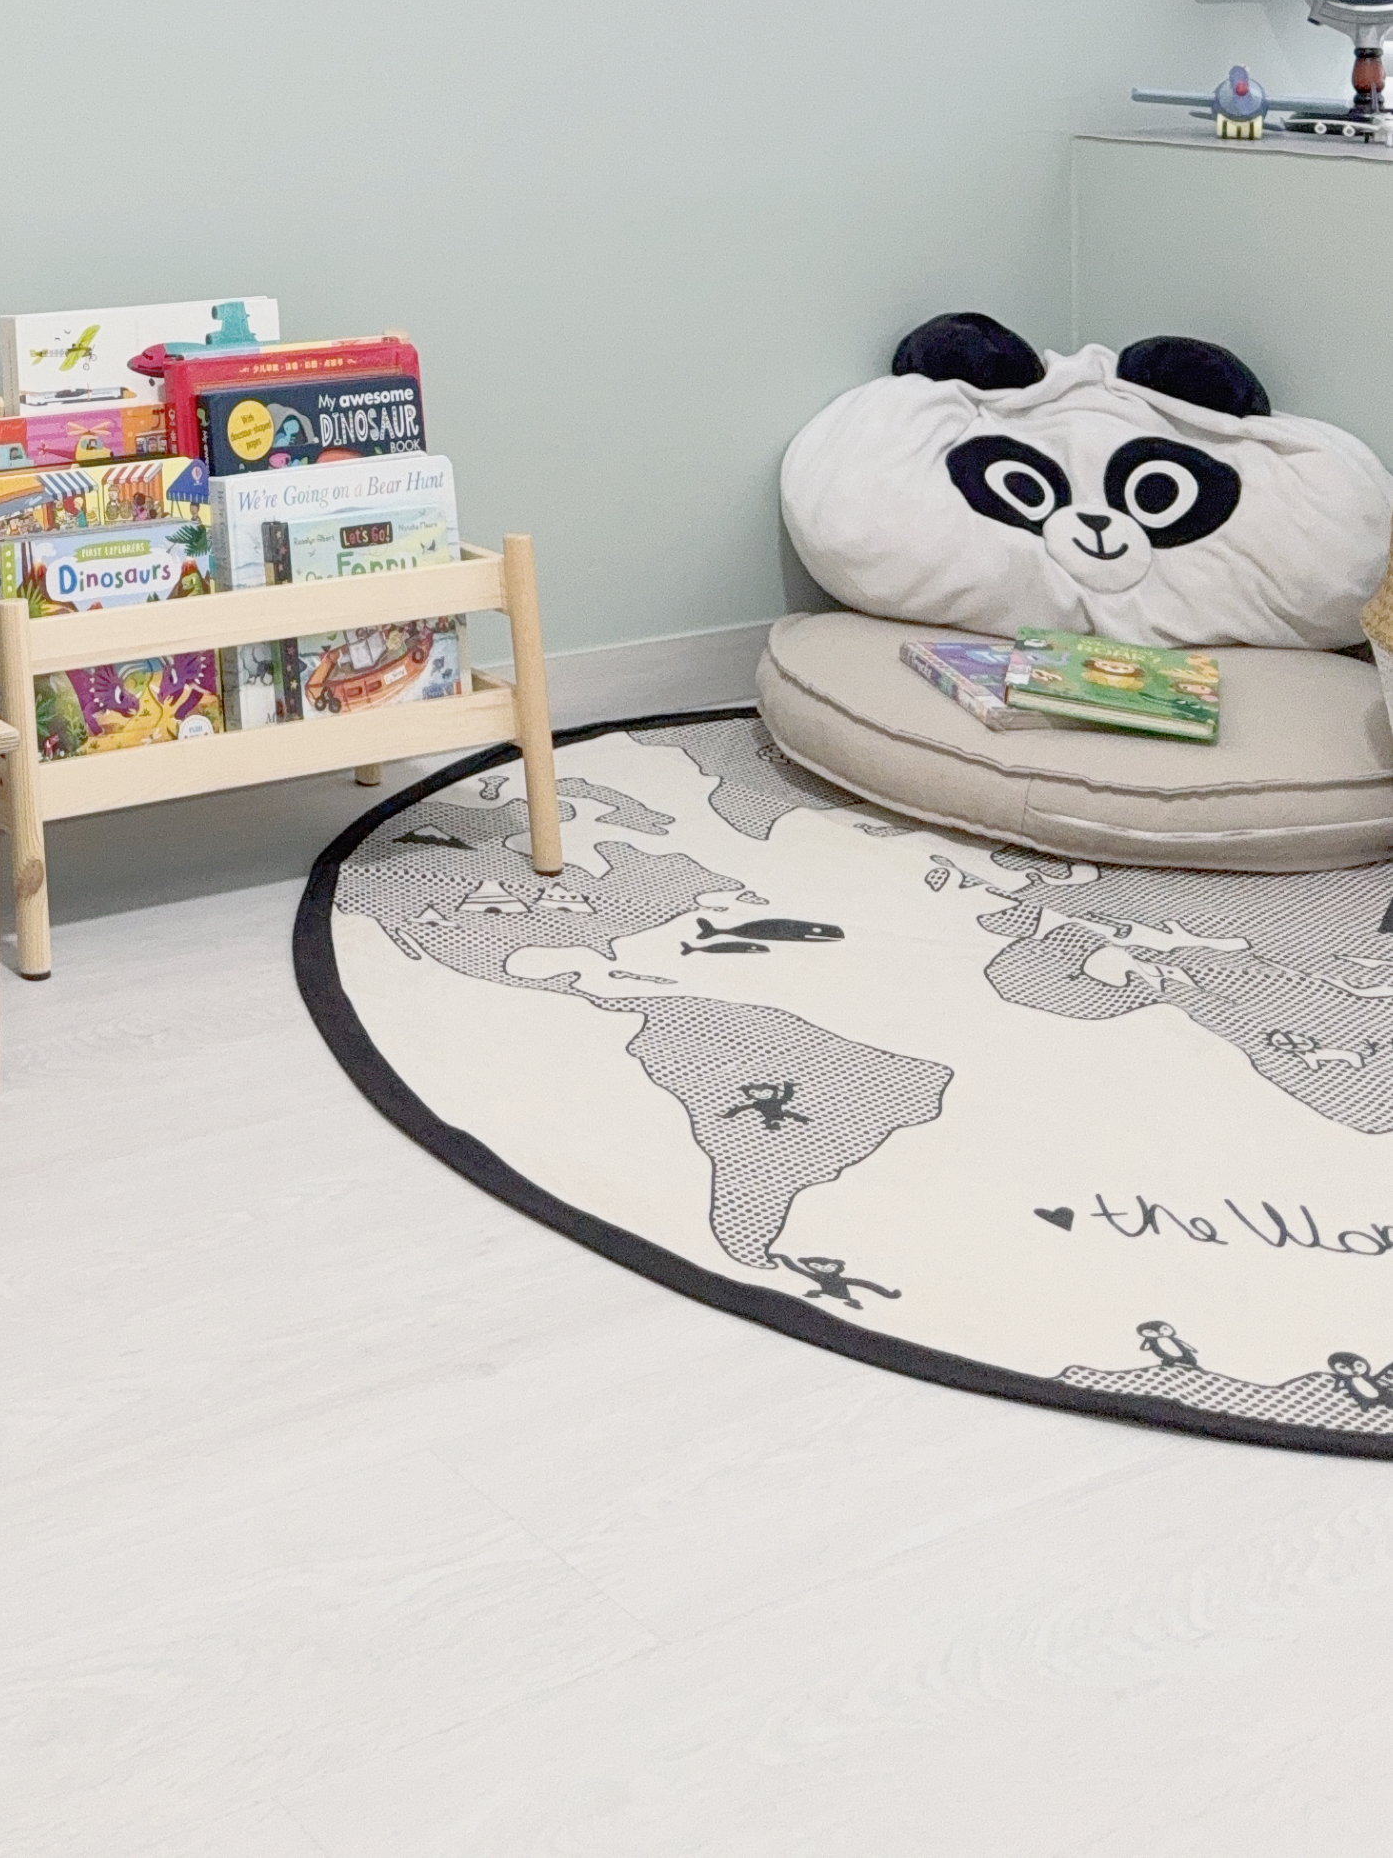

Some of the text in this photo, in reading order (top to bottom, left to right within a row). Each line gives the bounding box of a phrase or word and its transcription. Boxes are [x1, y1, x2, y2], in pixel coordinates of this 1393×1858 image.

[318, 388, 414, 411] My awesome
[320, 404, 419, 447] DINOSAUR
[391, 440, 420, 453] BOOK
[238, 470, 444, 511] We're Going on a Bear Hunt
[343, 524, 390, 546] Let's Go!
[81, 542, 145, 558] FIRST EXPLORERS
[59, 563, 171, 594] Dinosaurs
[1090, 1193, 1229, 1245] the
